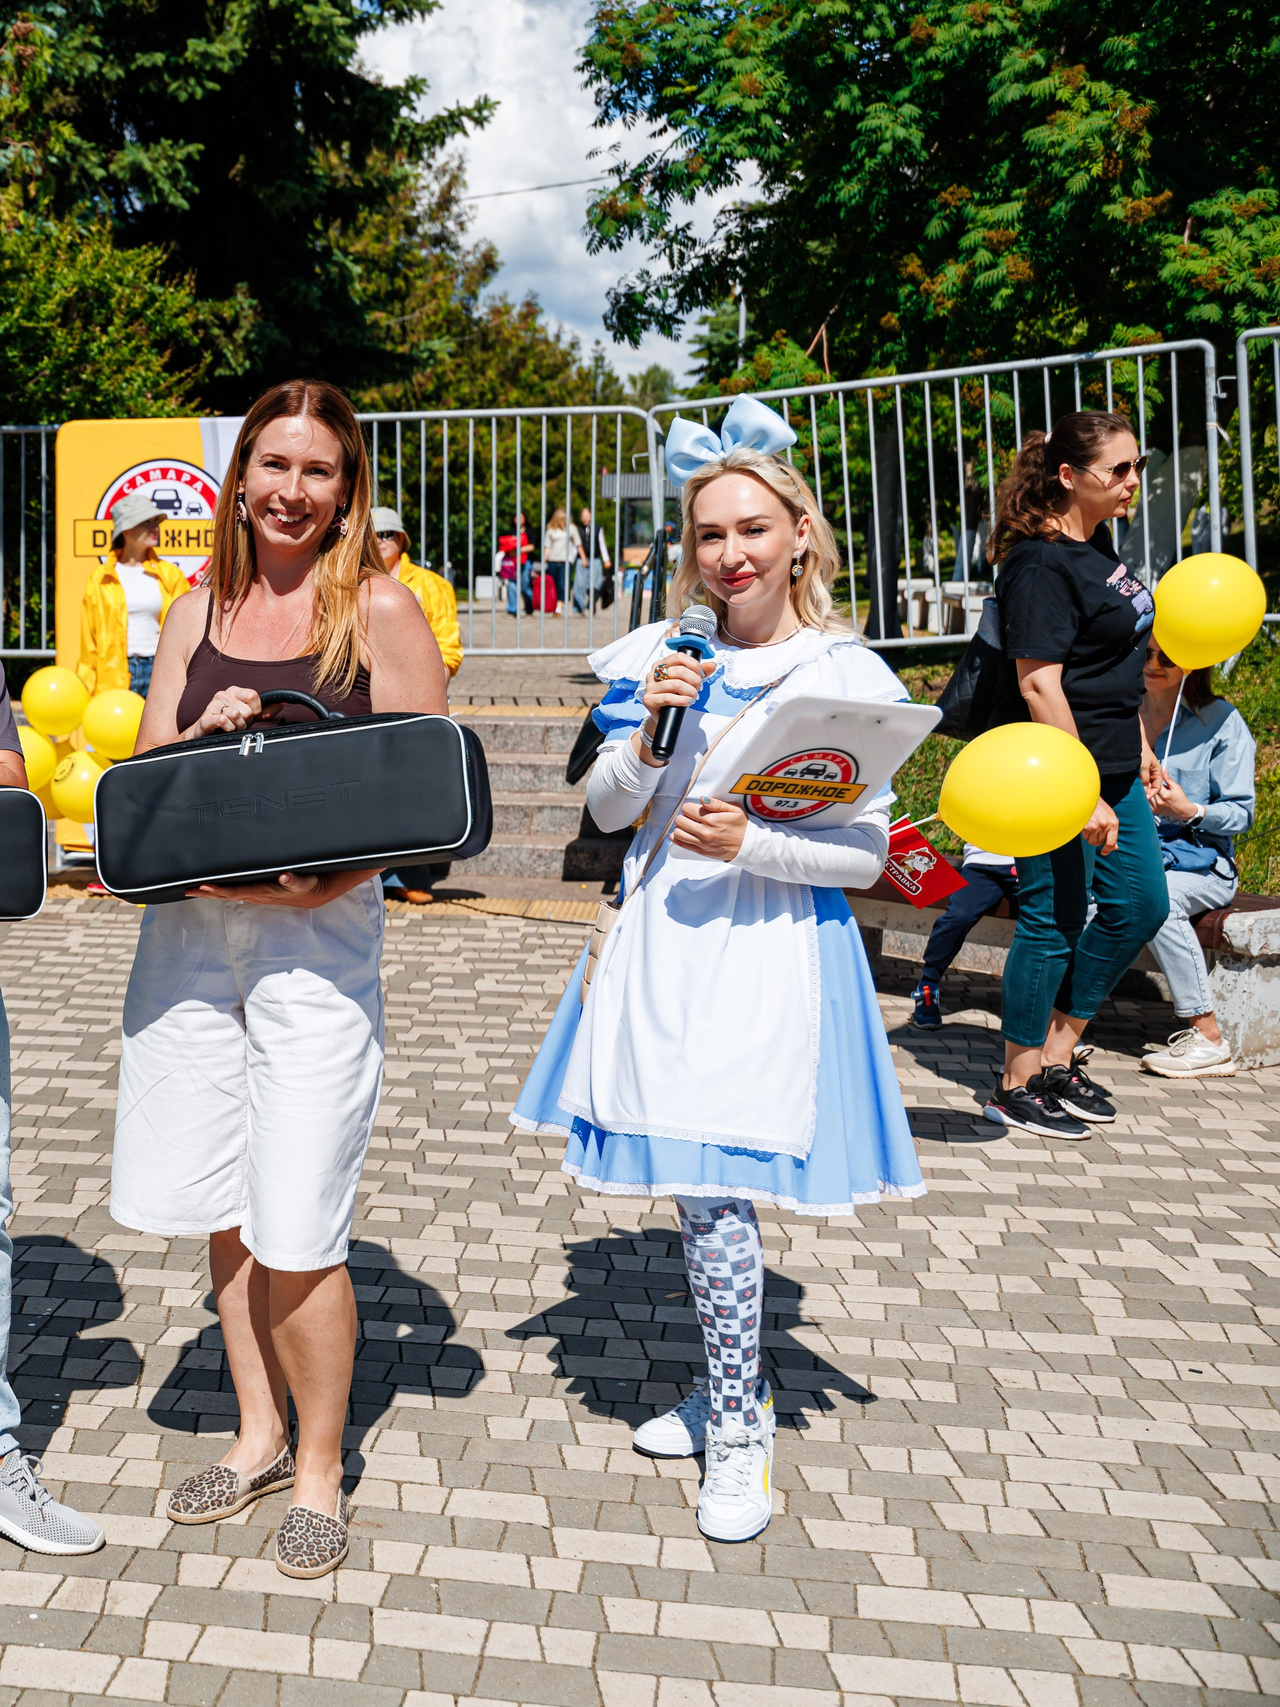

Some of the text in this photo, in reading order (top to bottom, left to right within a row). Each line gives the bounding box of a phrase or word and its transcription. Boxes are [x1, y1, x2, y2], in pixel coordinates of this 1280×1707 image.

[122, 469, 204, 494] САМАРА
[790, 753, 848, 768] САМАРА
[745, 779, 851, 799] ДОРОЖНОЕ
[186, 780, 362, 824] TENET
[755, 803, 811, 818] РАДИО
[774, 799, 799, 809] 97.3
[885, 860, 917, 892] СТРАВКА
